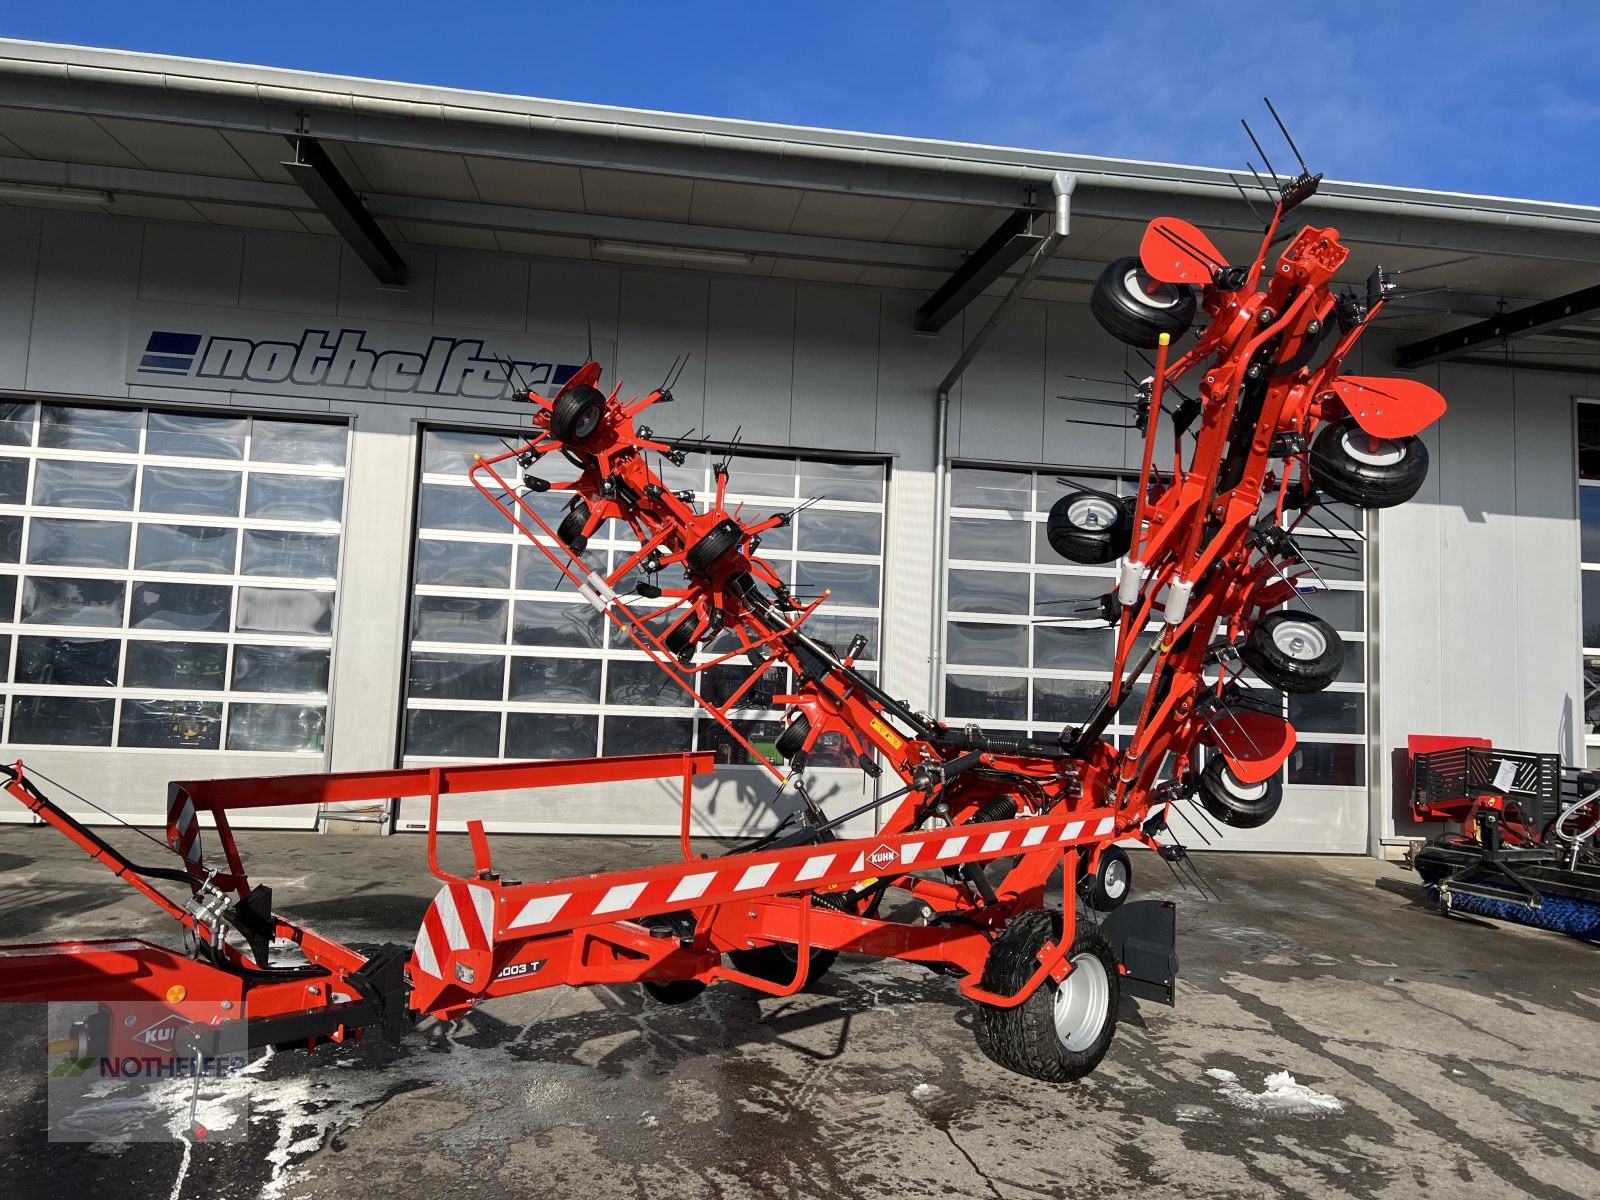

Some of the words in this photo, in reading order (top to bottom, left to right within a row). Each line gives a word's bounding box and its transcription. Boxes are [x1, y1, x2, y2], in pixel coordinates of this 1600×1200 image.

[871, 851, 894, 863] KUHN
[531, 961, 539, 971] T
[144, 1027, 174, 1043] KU
